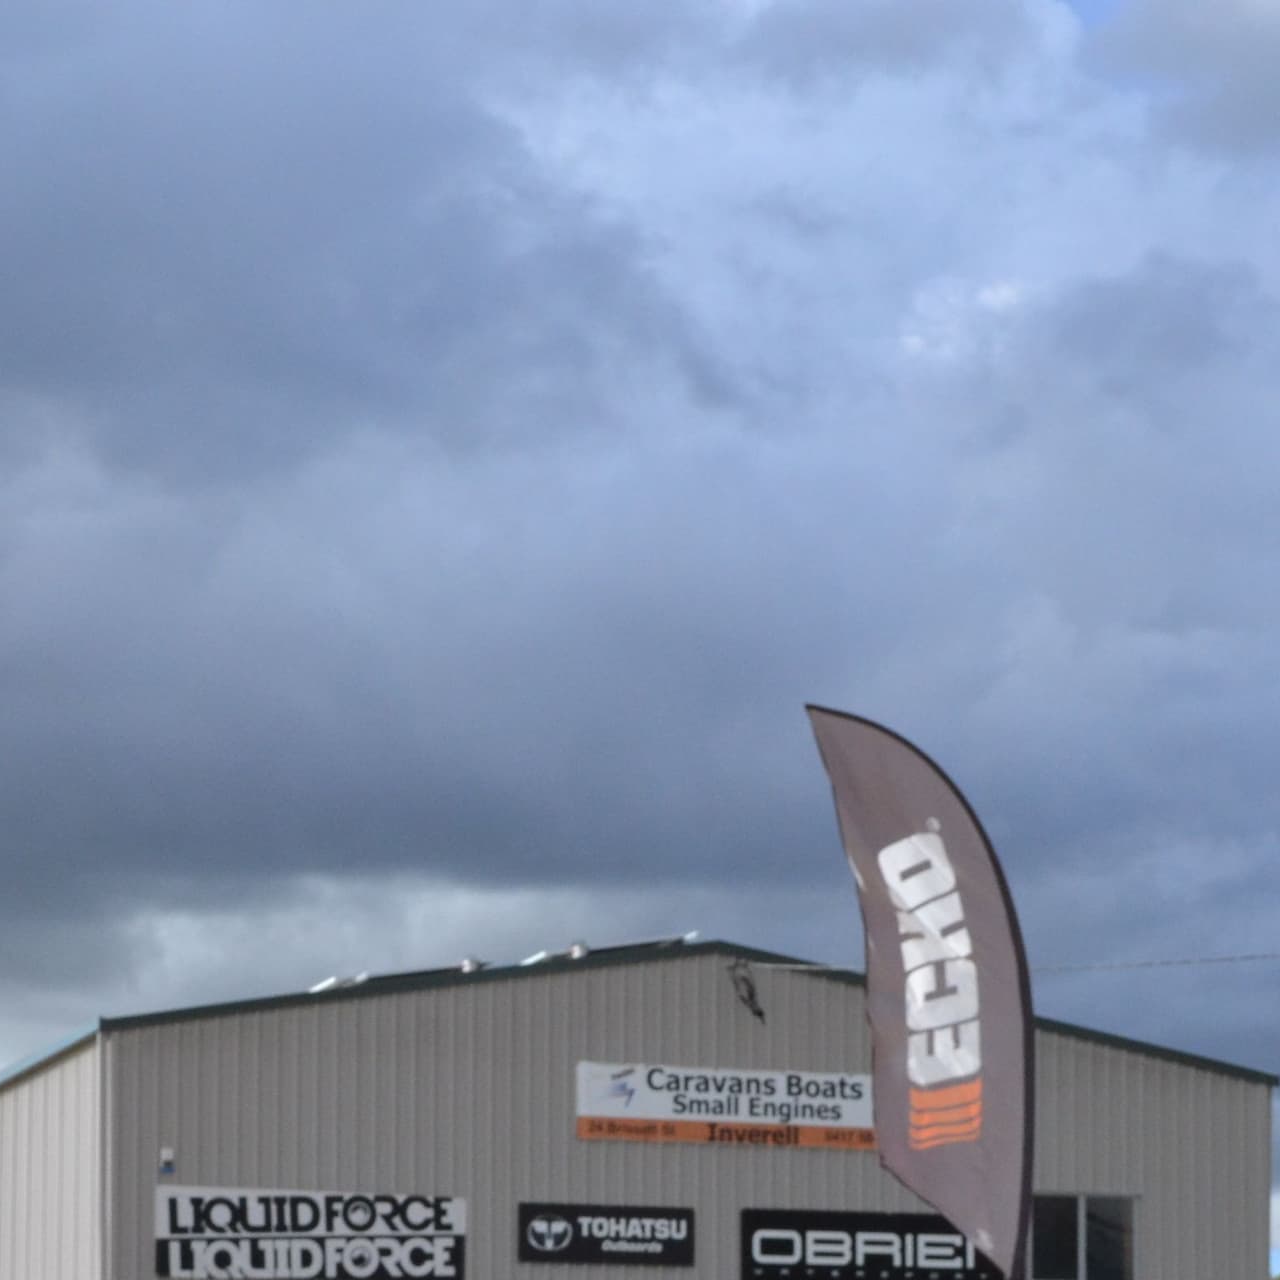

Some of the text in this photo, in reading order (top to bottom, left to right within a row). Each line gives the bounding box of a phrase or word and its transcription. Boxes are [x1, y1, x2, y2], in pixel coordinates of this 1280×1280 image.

[877, 832, 982, 1086] ECHO
[647, 1068, 863, 1100] Caravans Boats
[673, 1094, 842, 1123] Small Engines
[705, 1122, 800, 1145] Inverell
[577, 1216, 687, 1240] TOHATSU
[752, 1228, 976, 1270] OBRIE
